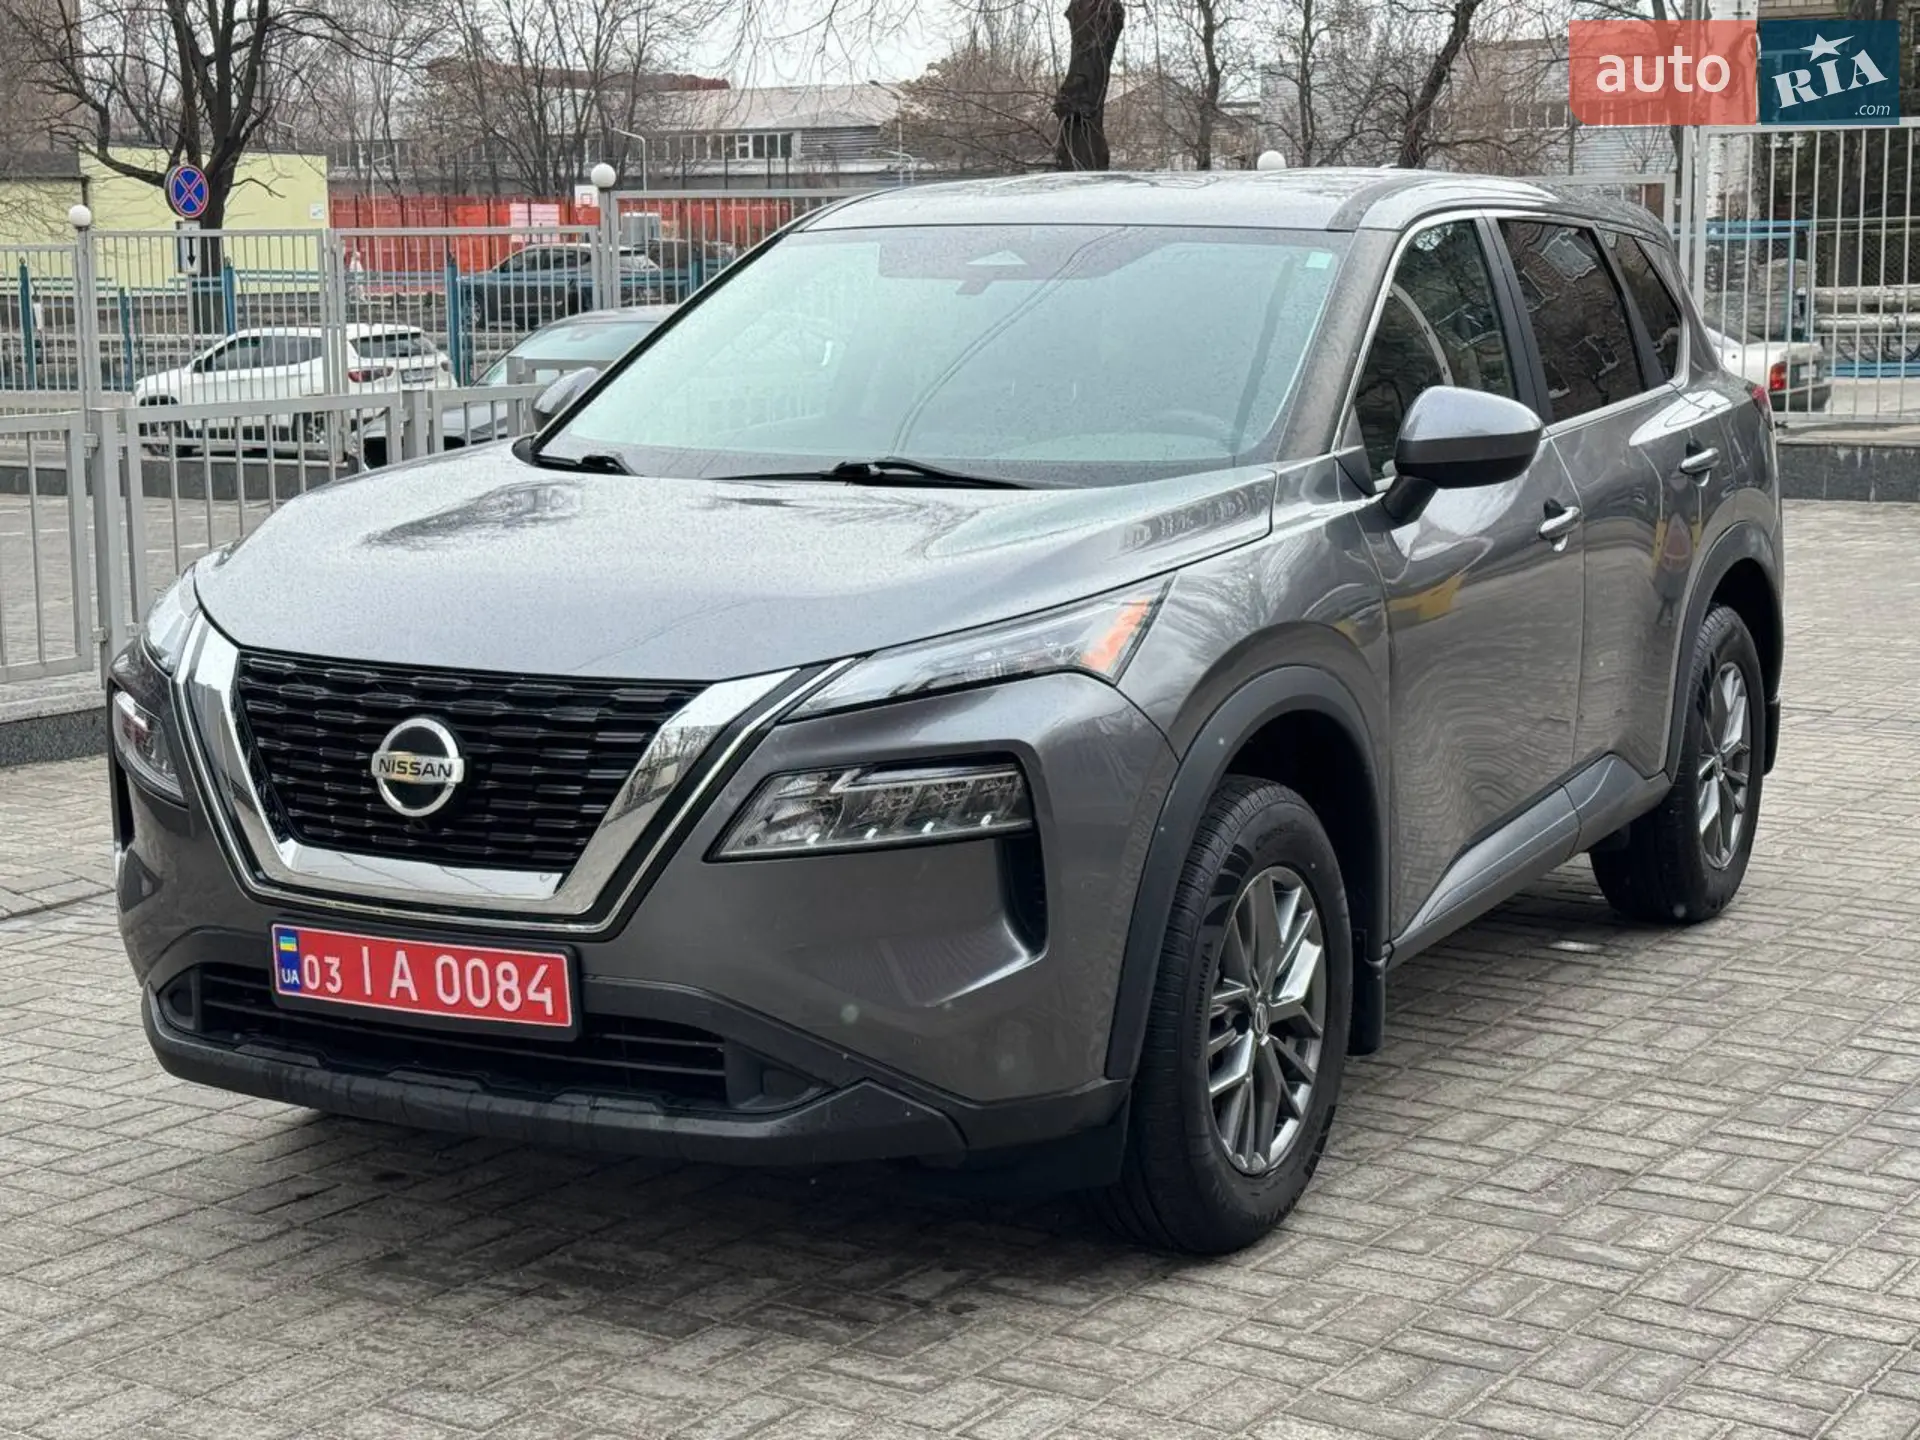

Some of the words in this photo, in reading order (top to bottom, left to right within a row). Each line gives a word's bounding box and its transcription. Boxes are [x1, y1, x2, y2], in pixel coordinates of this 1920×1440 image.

[378, 758, 453, 778] NISSAN
[281, 968, 300, 985] UA
[304, 954, 342, 994] 03
[434, 954, 554, 1016] 0084
